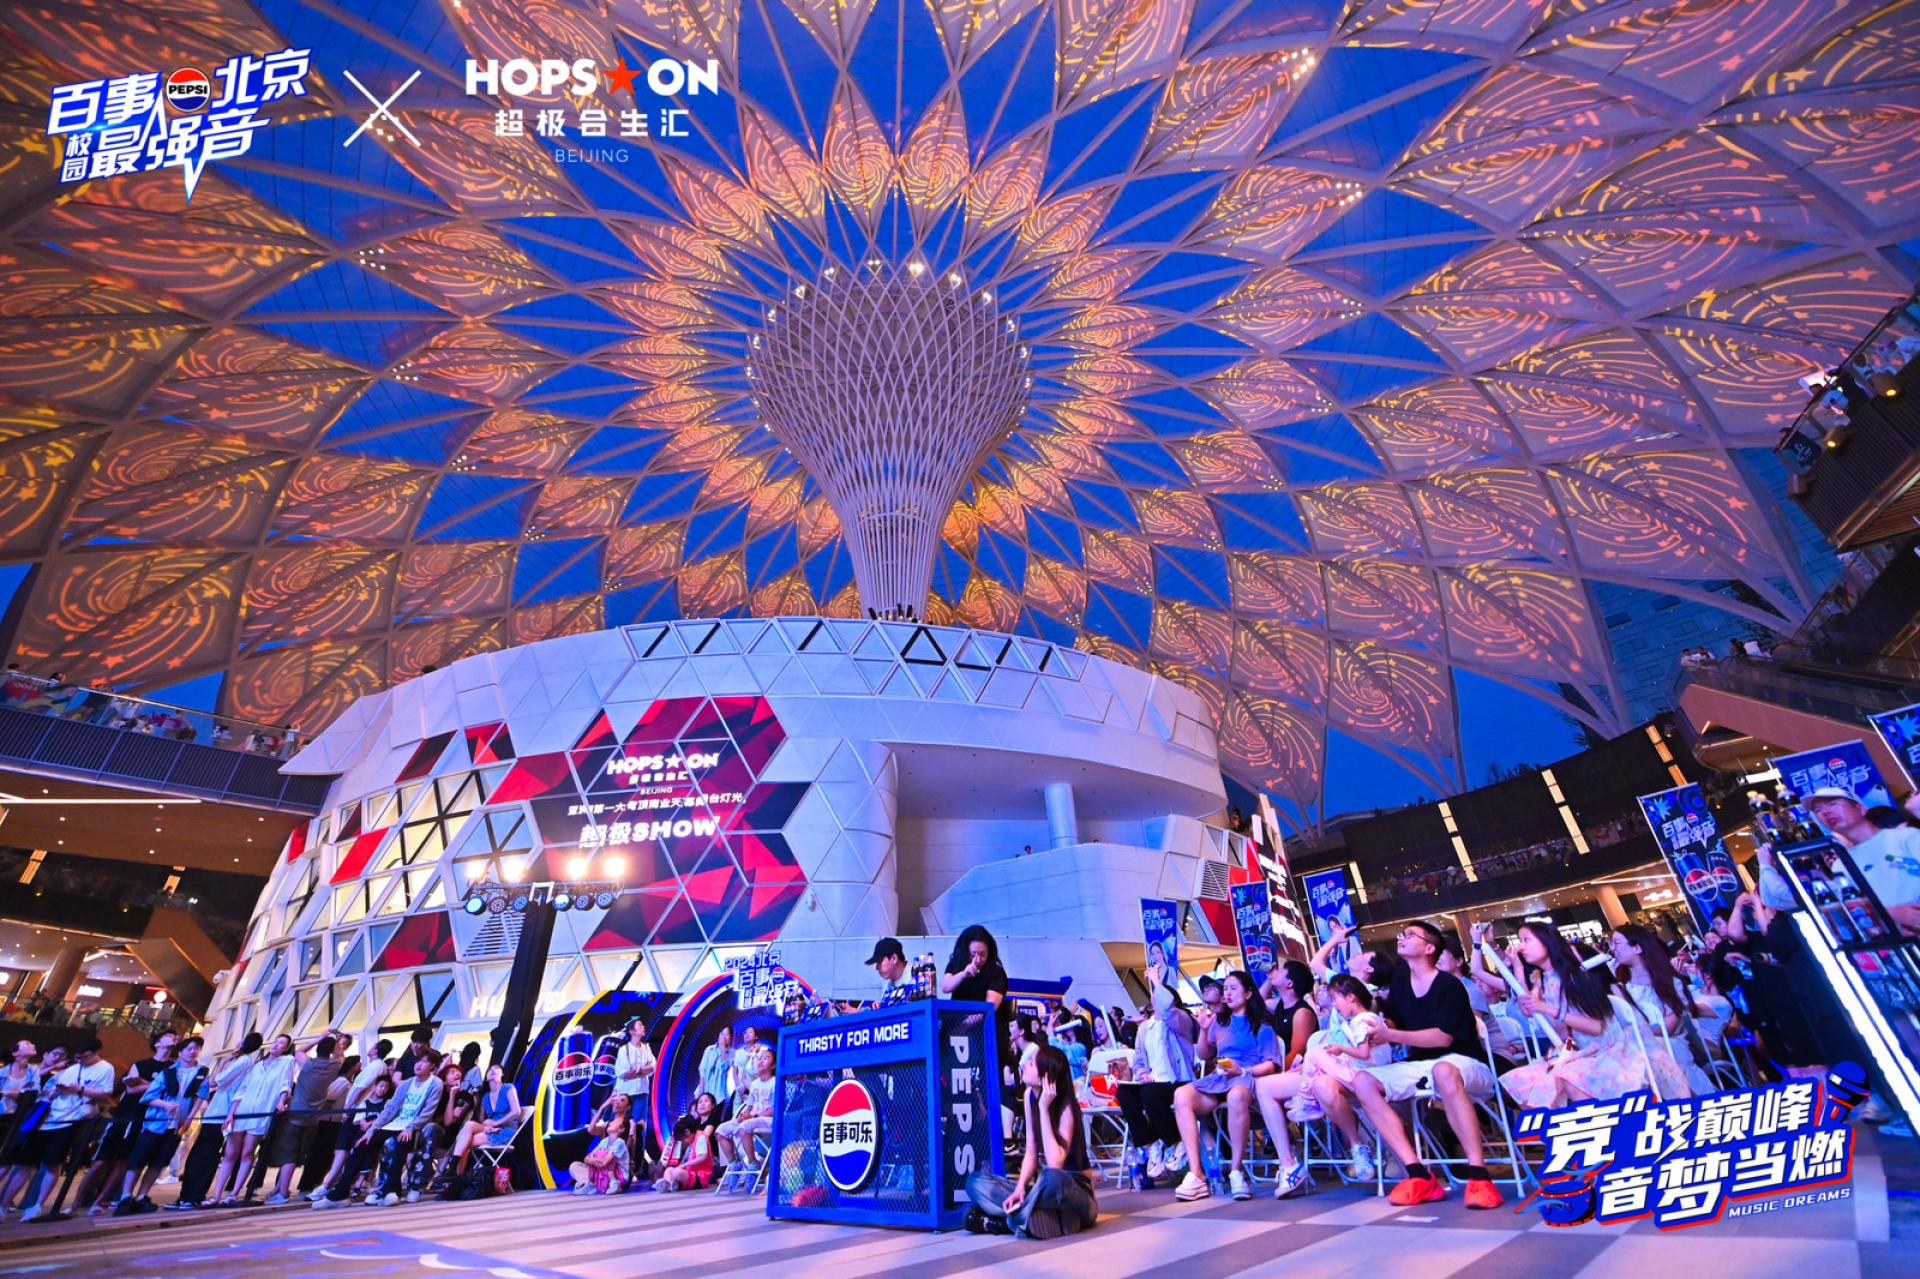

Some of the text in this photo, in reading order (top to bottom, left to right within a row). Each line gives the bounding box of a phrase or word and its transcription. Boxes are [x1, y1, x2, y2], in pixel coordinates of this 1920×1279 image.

[640, 786, 673, 795] BEIJING
[798, 1022, 909, 1054] THIRSTY FOR MORE
[823, 1121, 873, 1144] 百事可乐
[950, 1036, 976, 1202] PEPSI
